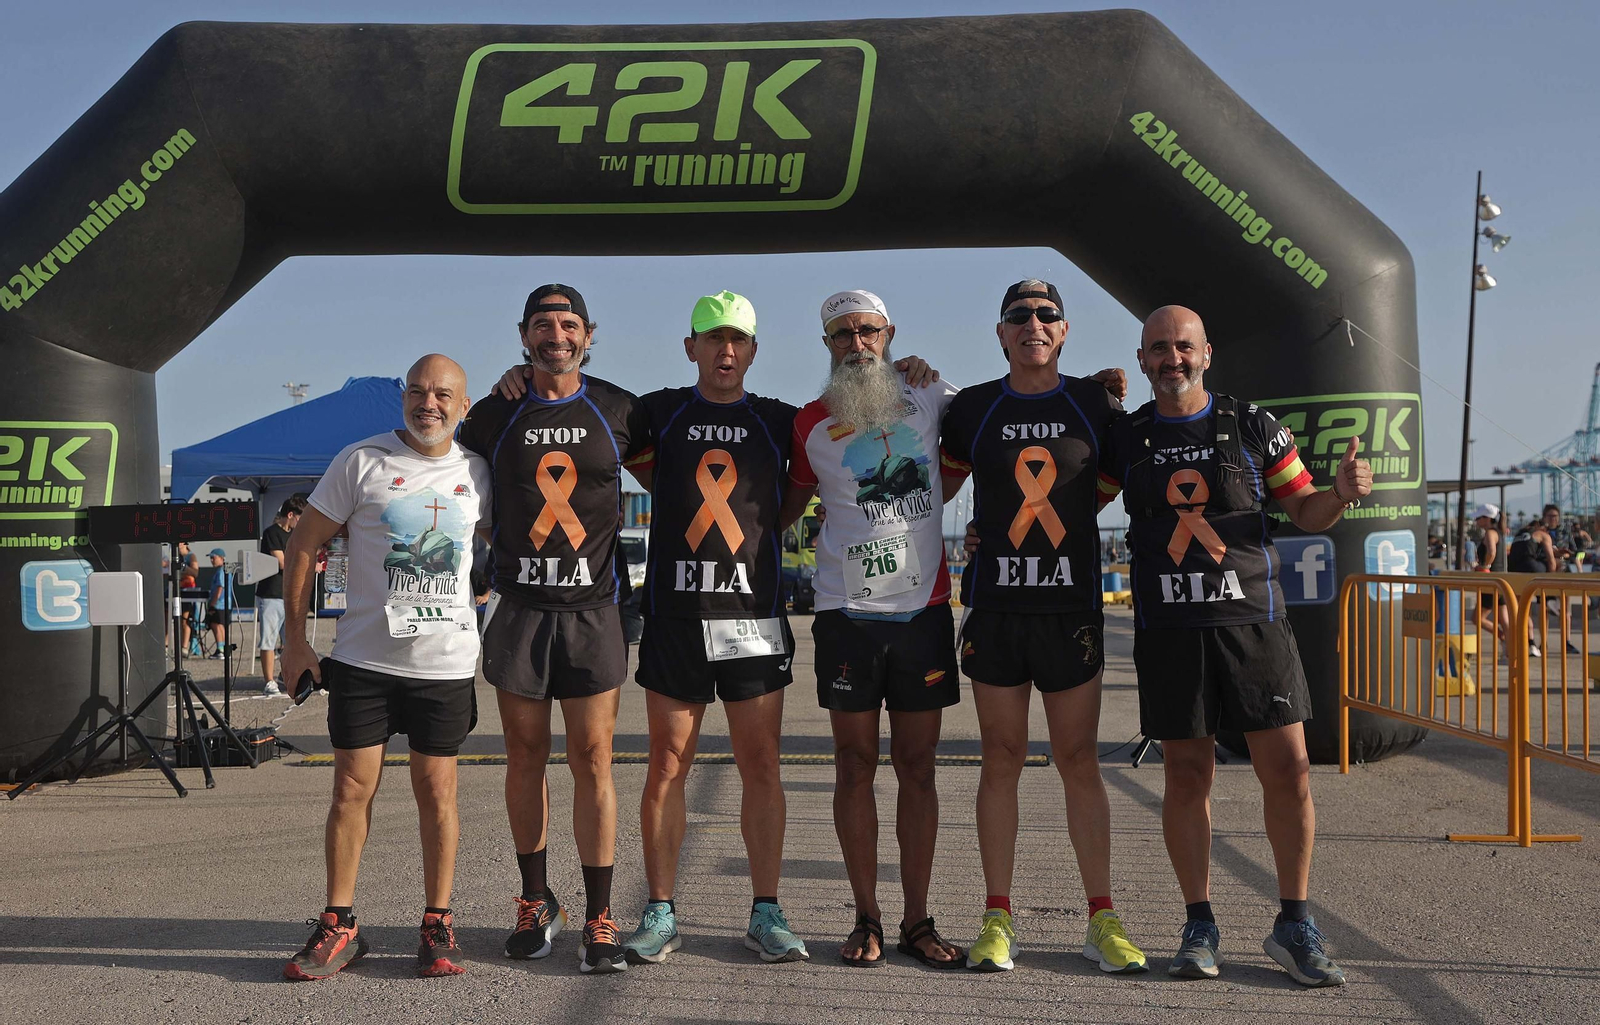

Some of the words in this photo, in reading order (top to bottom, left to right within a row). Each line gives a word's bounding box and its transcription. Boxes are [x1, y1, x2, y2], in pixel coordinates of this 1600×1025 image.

[499, 58, 822, 144] 42K
[599, 155, 627, 171] TM
[632, 142, 806, 194] running
[1129, 111, 1329, 289] 42krunning.com
[0, 128, 197, 312] 42krunning.com
[524, 427, 587, 445] STOP
[688, 425, 748, 443] STOP
[1002, 422, 1066, 441] STOP
[862, 500, 888, 521] Vive
[890, 495, 905, 517] la
[905, 489, 932, 515] vida
[134, 505, 254, 538] 1:45:07
[848, 541, 879, 555] XXVI
[386, 567, 415, 592] Vive
[417, 571, 431, 594] la
[435, 572, 457, 595] vida
[517, 557, 594, 587] ELA
[674, 560, 753, 594] ELA
[862, 552, 897, 579] 216
[996, 556, 1074, 587] ELA
[1159, 570, 1247, 603] ELA
